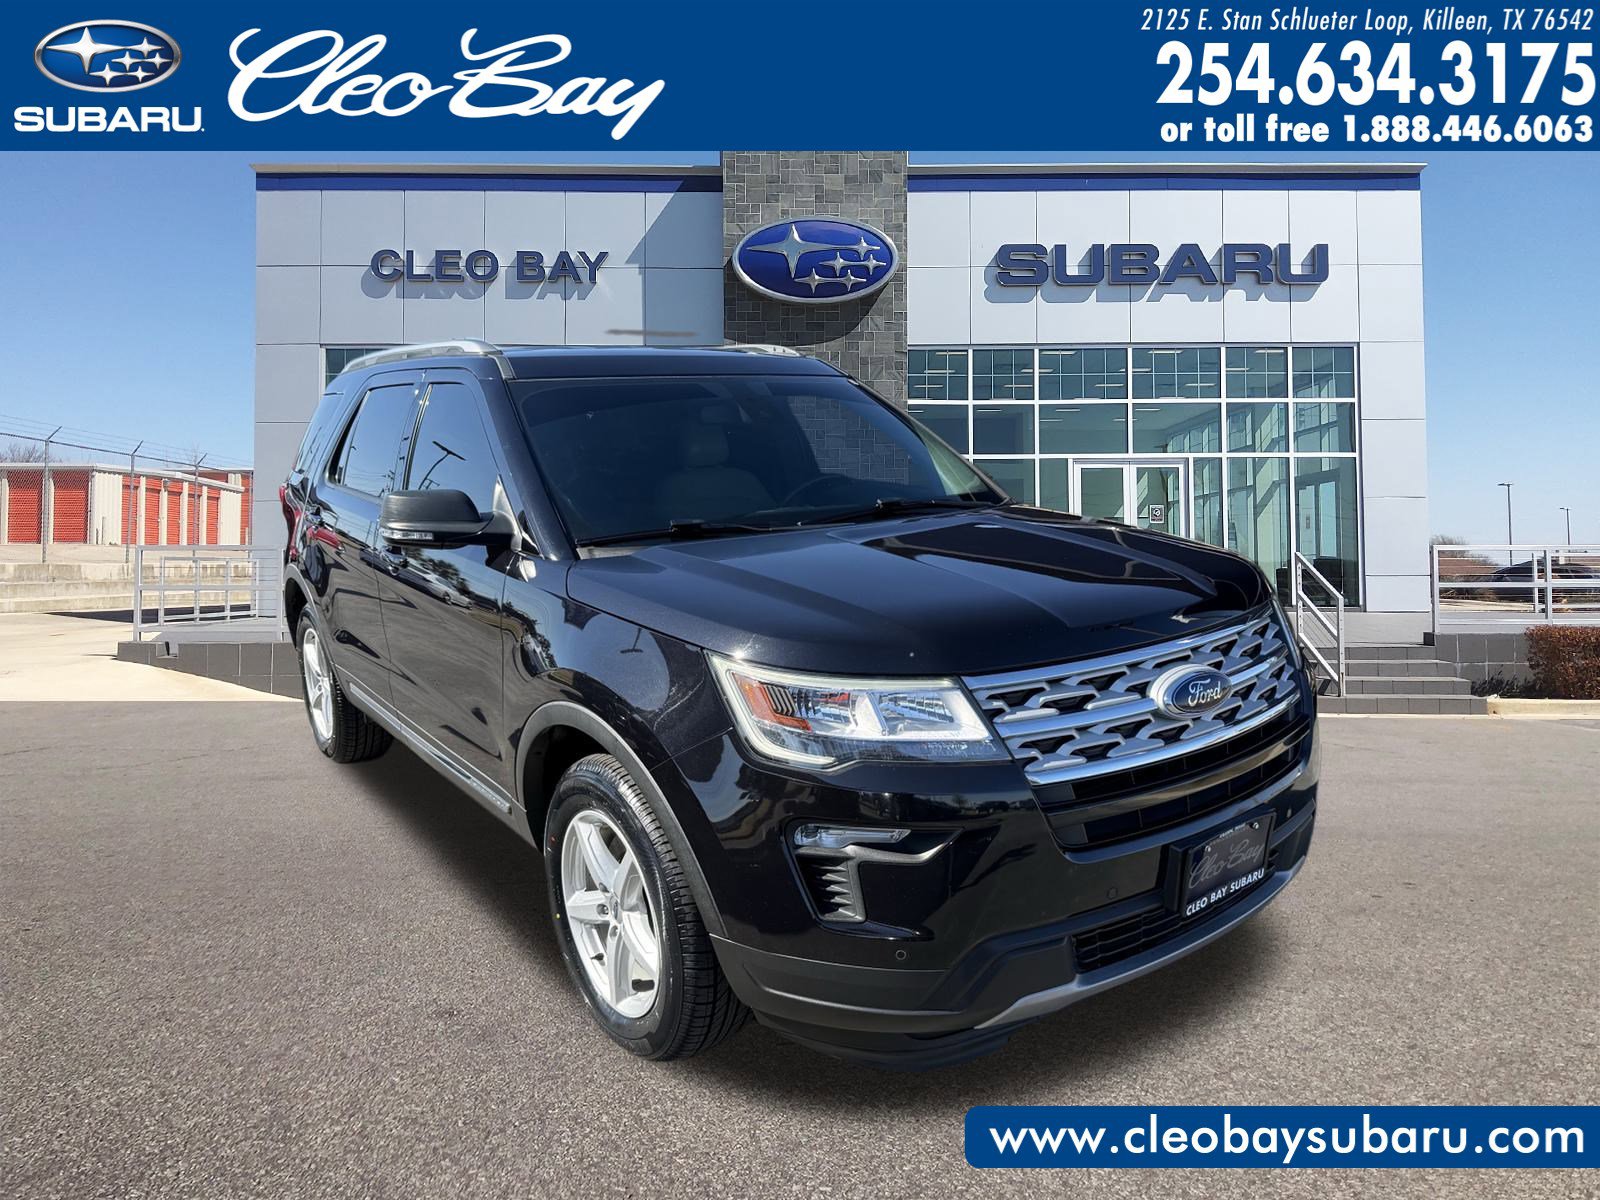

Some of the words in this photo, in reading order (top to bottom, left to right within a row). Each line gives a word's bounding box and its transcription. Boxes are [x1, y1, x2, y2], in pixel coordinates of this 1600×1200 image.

[370, 249, 499, 282] CLEO
[516, 250, 609, 283] BAY
[996, 243, 1330, 286] SUBARU
[1188, 678, 1221, 707] Ford
[1186, 897, 1208, 916] CLEO
[1210, 886, 1228, 903] BAY
[1229, 868, 1265, 892] SUBARU
